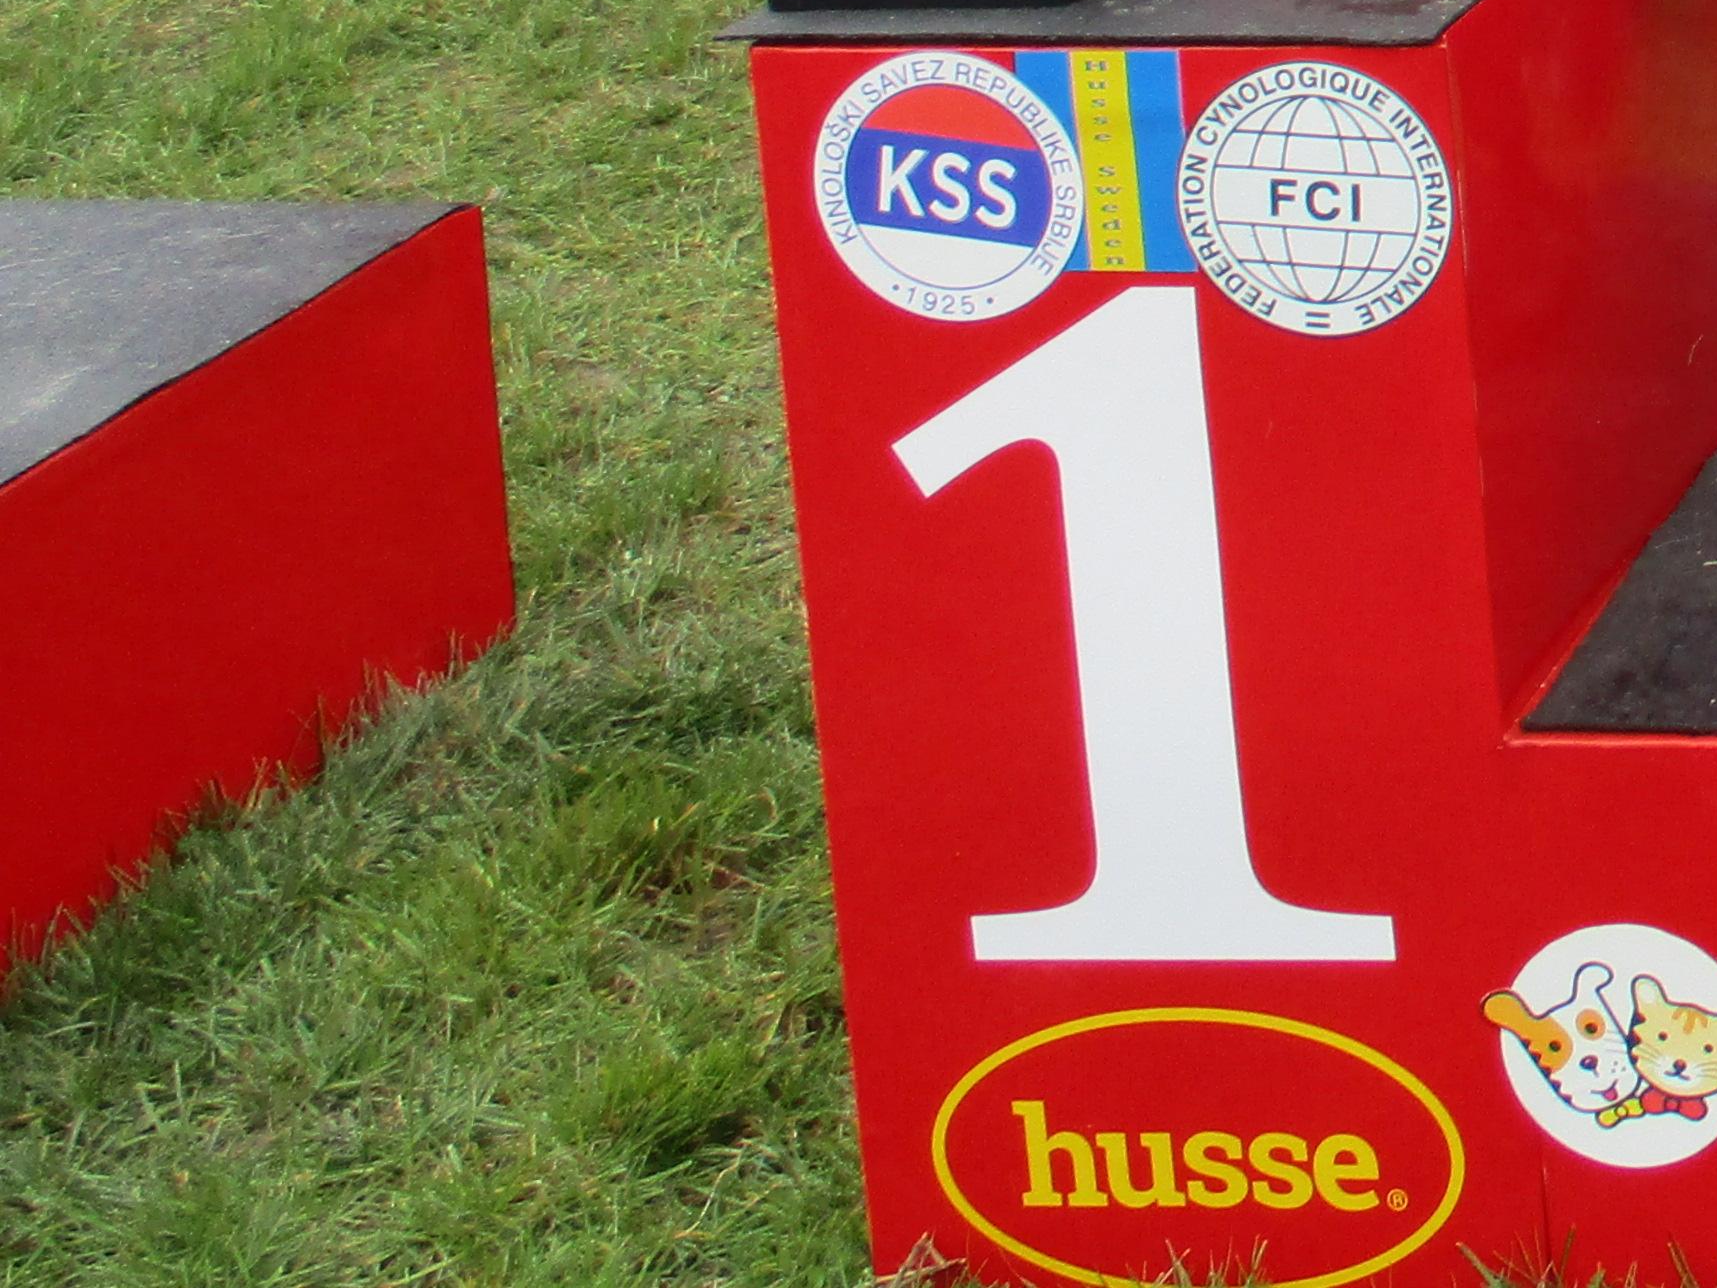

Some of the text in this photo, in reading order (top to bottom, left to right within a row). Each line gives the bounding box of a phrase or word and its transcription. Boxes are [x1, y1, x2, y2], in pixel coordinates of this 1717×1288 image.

[820, 59, 1079, 277] KINOLOŠKI SAVEZ REPUBLIKE SRBIJE
[877, 145, 1018, 231] KSS
[1183, 66, 1448, 327] FEDERATION CYNOLOGIQUE INTERNATIONALE
[1267, 178, 1363, 223] FCI
[905, 284, 977, 317] 1925
[891, 286, 1397, 962] 1
[1012, 1100, 1380, 1209] husse
